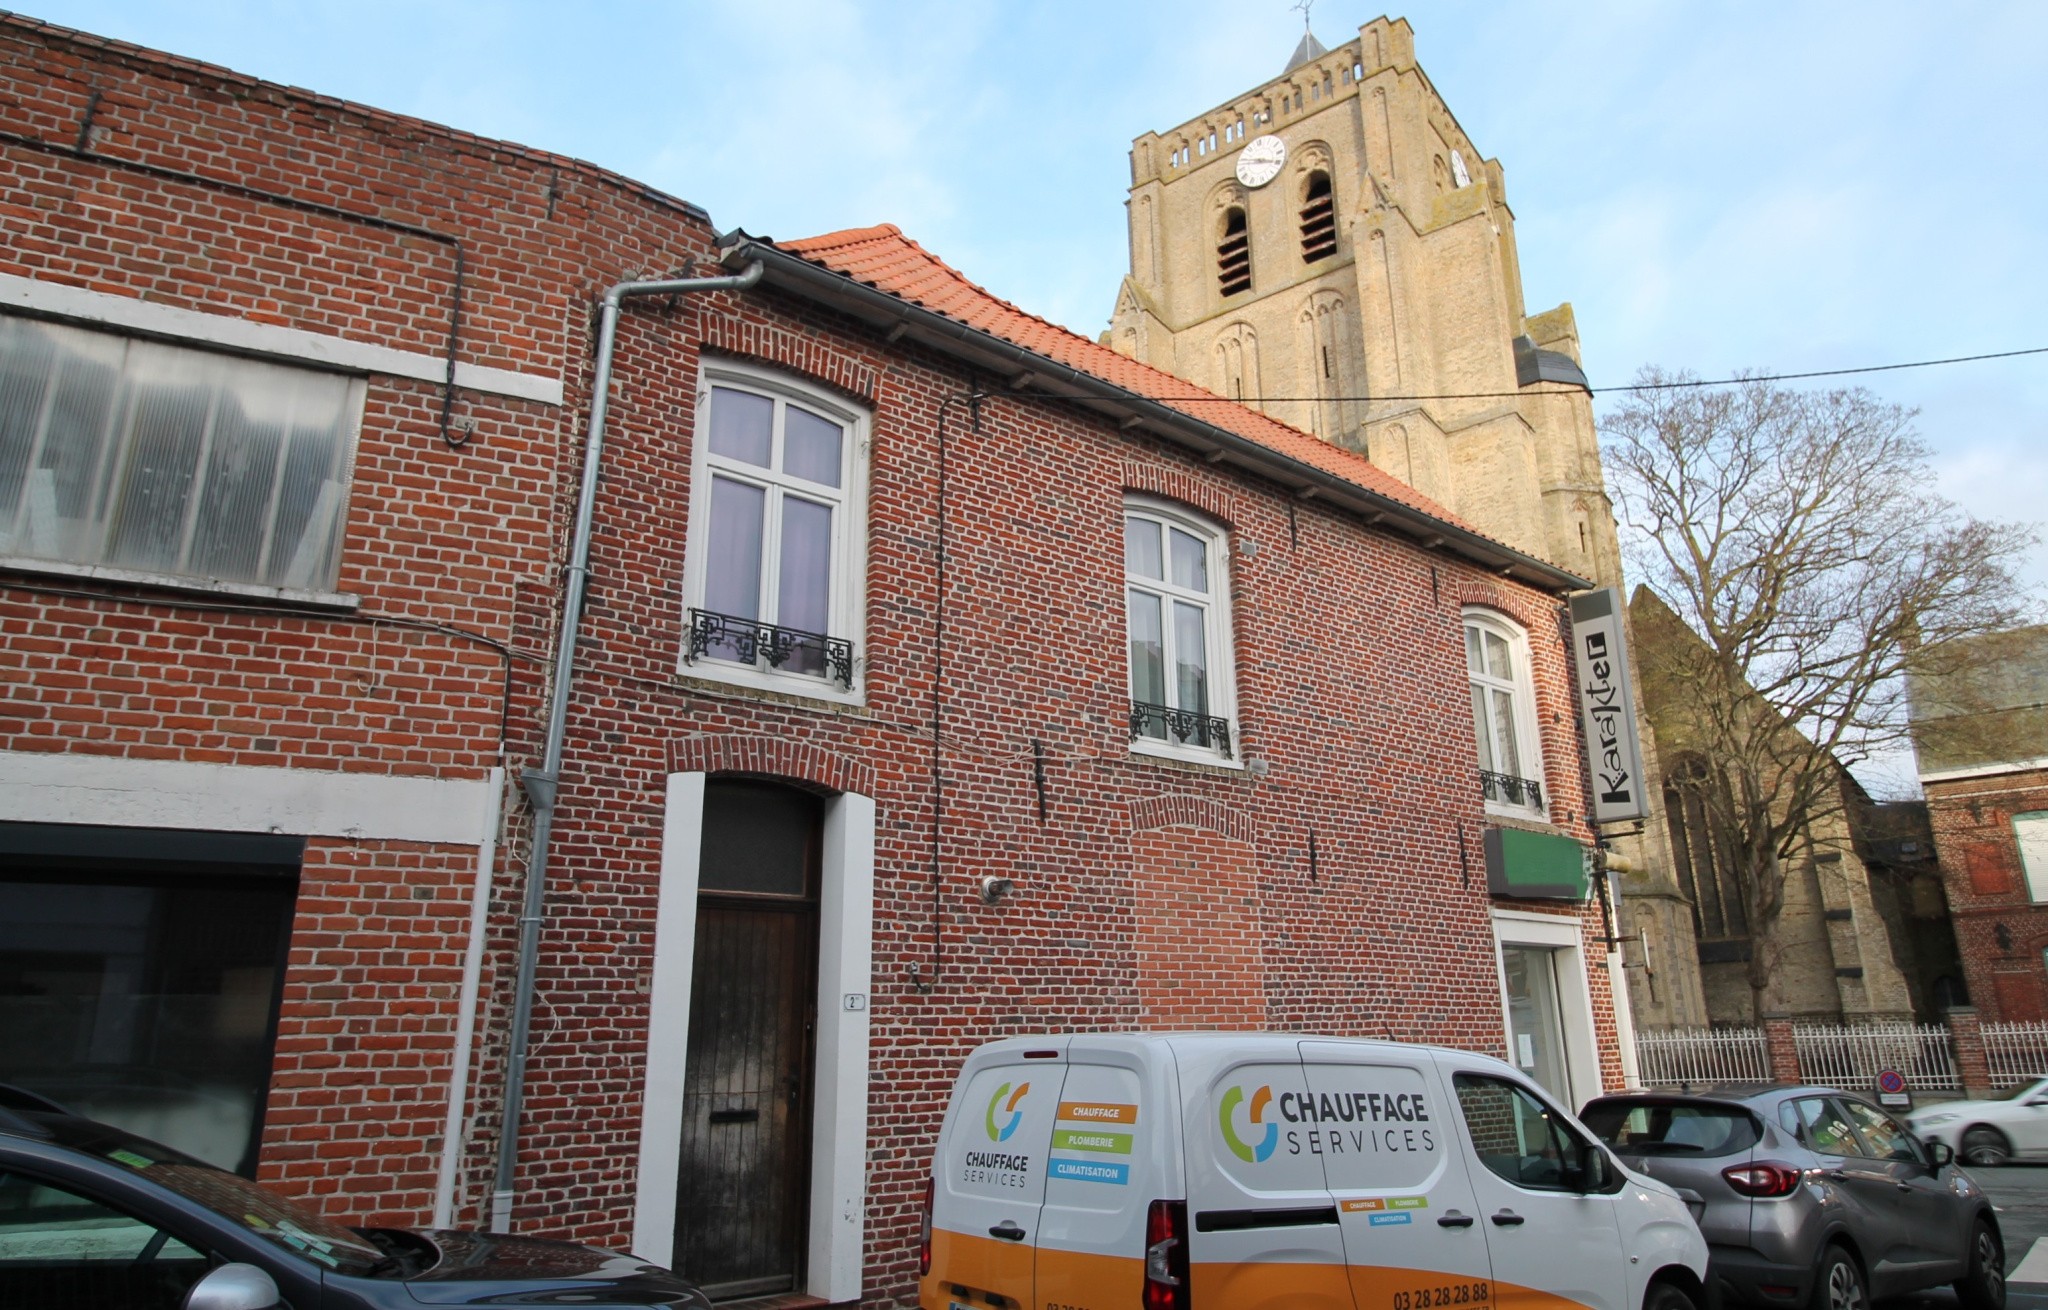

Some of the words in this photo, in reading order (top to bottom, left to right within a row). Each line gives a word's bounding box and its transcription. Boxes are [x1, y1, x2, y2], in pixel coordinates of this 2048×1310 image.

[1585, 631, 1631, 804] Karakter
[1072, 1106, 1120, 1118] CHAUFFAGE
[1279, 1092, 1429, 1123] CHAUFFAGE
[1068, 1135, 1114, 1147] PLOMBERIE
[1287, 1129, 1434, 1155] SERVICES
[966, 1151, 1028, 1172] CHAUFFAGE
[1057, 1163, 1119, 1179] CLIMATISATION
[964, 1169, 1025, 1188] SERVICES
[1393, 1291, 1411, 1310] 03
[1414, 1289, 1431, 1309] 28
[1434, 1286, 1451, 1307] 28
[1453, 1284, 1470, 1304] 28
[1472, 1282, 1488, 1302] 88
